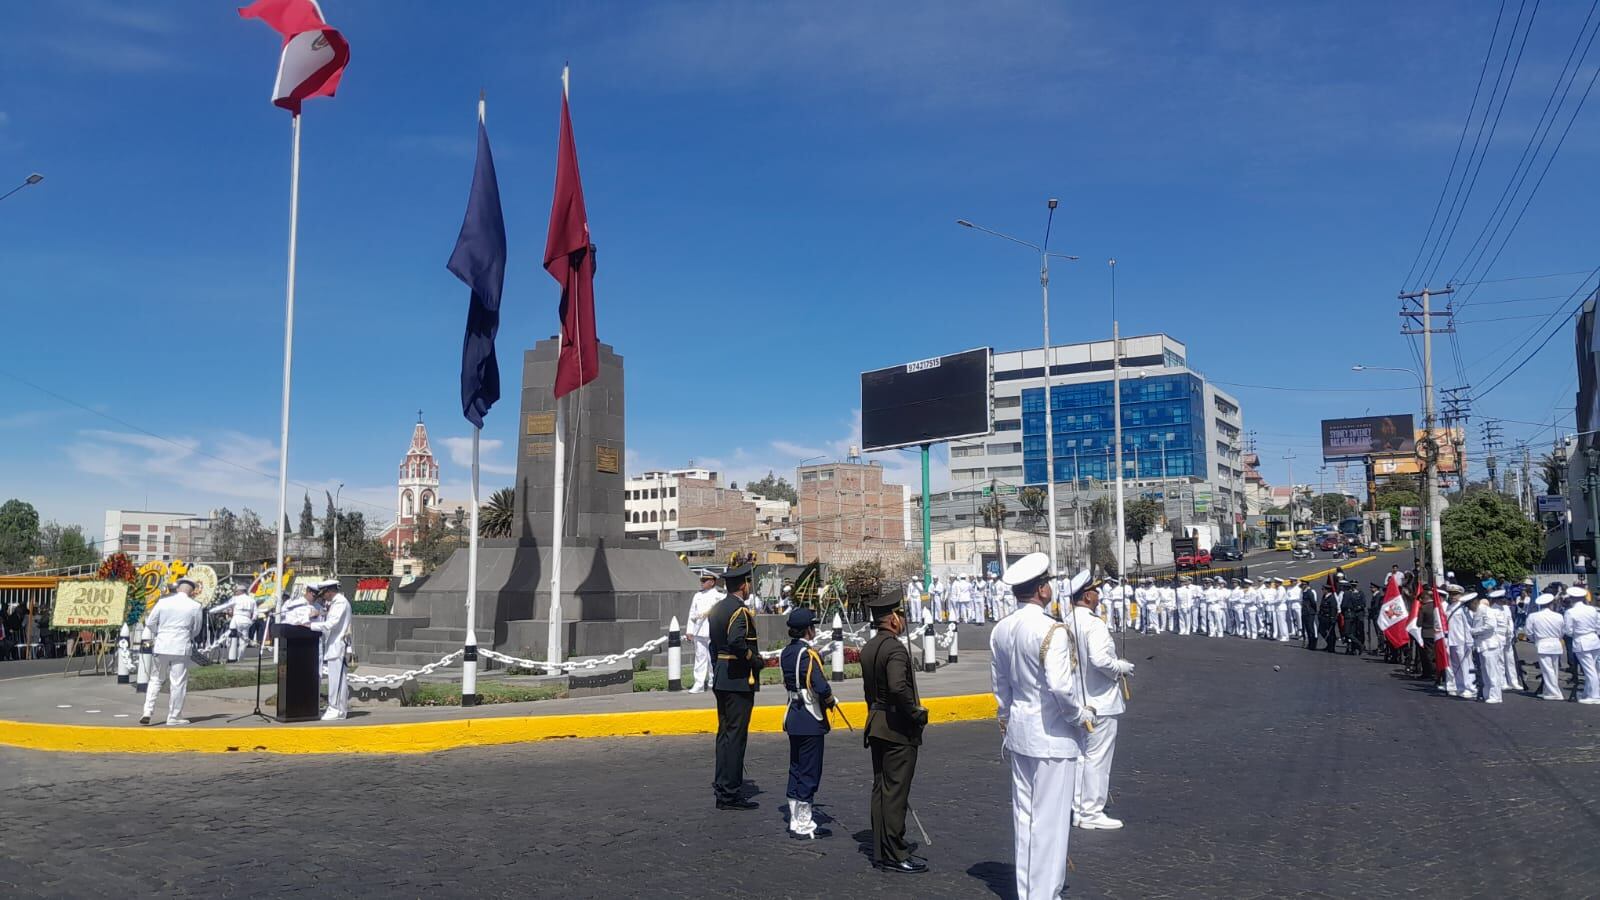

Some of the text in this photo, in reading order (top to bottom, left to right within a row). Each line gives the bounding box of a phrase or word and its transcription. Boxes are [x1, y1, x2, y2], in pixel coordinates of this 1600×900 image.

[908, 357, 939, 371] 974217515
[73, 587, 114, 605] 200
[78, 617, 108, 625] Peruano
